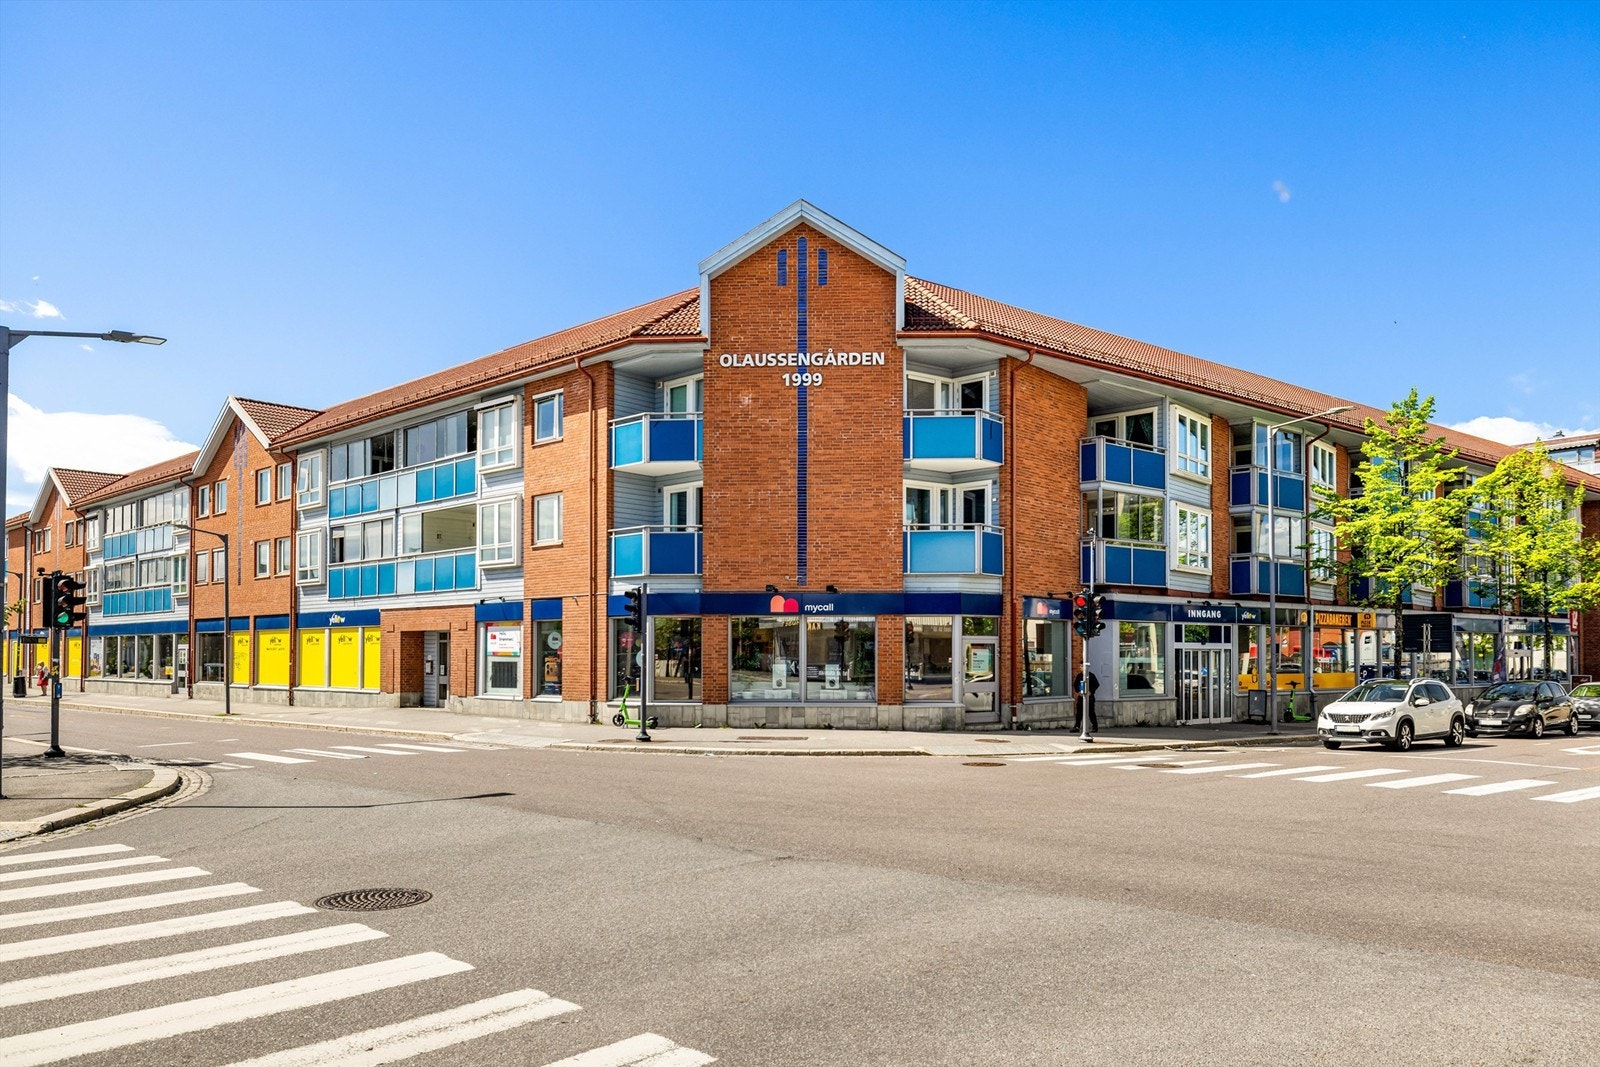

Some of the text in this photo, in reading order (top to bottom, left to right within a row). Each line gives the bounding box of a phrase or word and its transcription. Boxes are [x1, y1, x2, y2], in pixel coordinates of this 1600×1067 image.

[719, 348, 885, 367] OLAUSSENGÅRDEN
[782, 373, 823, 387] 1999
[804, 603, 834, 614] mycall
[1187, 609, 1222, 618] INNGANG
[329, 613, 345, 625] yellow
[269, 635, 282, 645] yellw
[306, 634, 320, 645] yellw
[337, 633, 352, 645] yellw
[365, 633, 380, 644] yellw
